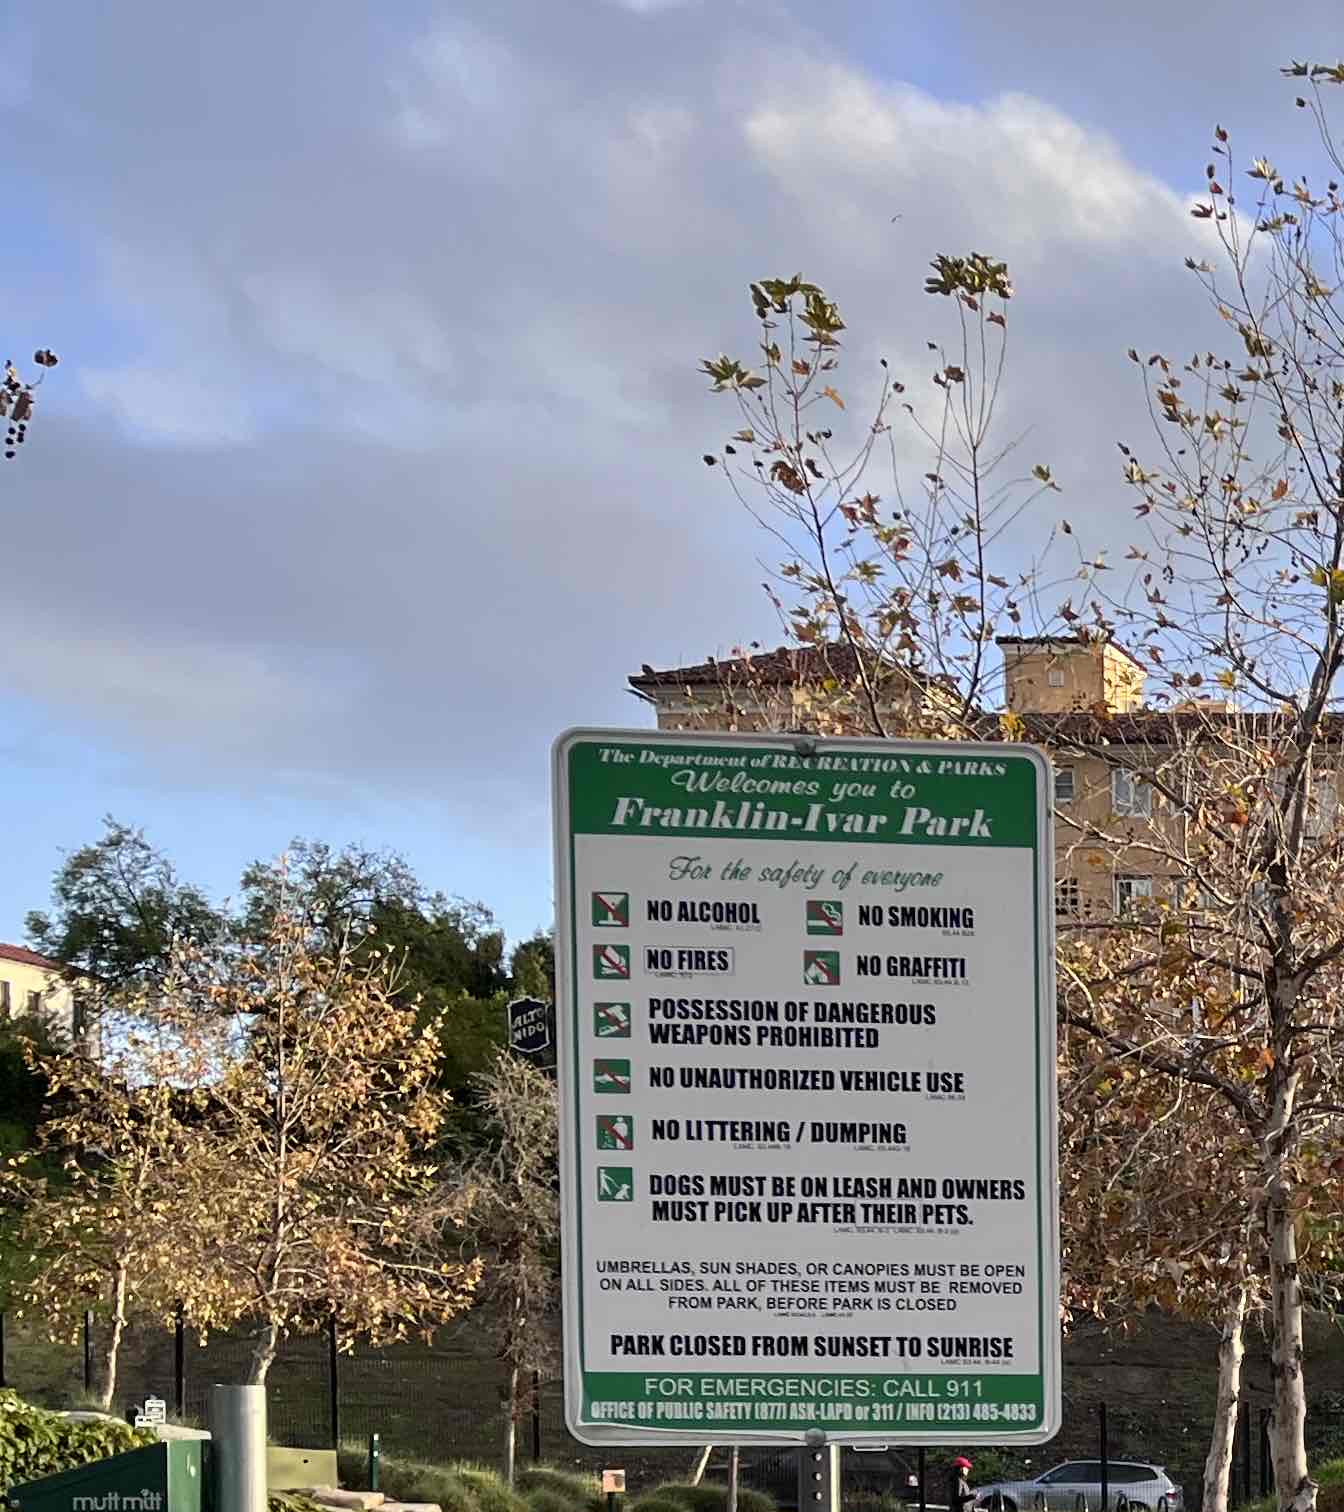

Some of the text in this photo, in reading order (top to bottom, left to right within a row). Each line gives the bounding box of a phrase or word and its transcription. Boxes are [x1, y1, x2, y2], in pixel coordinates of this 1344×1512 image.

[600, 749, 1007, 776] The Department of RECREATION & PARKS
[671, 769, 916, 801] Welcomes you to
[609, 797, 993, 838] Franklin-Ivar Park
[669, 856, 944, 892] For the safety of everyone
[647, 900, 760, 925] NO ALCOHOL
[859, 905, 974, 931] NO SMOKING
[647, 949, 729, 973] NO FIRES
[857, 955, 967, 980] NO GRAFFITI
[649, 998, 936, 1027] POSSESSION OF DANGEROUS
[513, 1022, 545, 1043] NIDO
[649, 1024, 878, 1048] WEAPONS PROHIBITED
[650, 1067, 965, 1095] NO UNAUTHORIZED VEHICLE USE
[653, 1120, 906, 1146] NO LITTERING / DUMPING
[650, 1175, 1025, 1200] DOGS MUST BE ON LEASH AND OWNERS
[653, 1201, 973, 1226] MUST PICK UP AFTER THEIR PETS.
[597, 1261, 1024, 1277] UMBRELLAS, SUN SHADES, OR CANOPIES MUST BE OPEN
[600, 1278, 1022, 1294] ON ALL SIDES. ALL OF THESE ITEMS MUST BE REMOVED
[669, 1297, 956, 1310] FROM PARK, BEFORE PARK IS CLOSED
[611, 1335, 1013, 1360] PARK CLOSED FROM SUNSET TO SUNRISE
[646, 1379, 983, 1397] FOR EMERGENCIES: CALL 911
[591, 1401, 634, 1419] OFFICE
[637, 1401, 653, 1419] OF
[655, 1402, 703, 1420] PUBLIC
[706, 1402, 752, 1420] SAFETY
[789, 1403, 852, 1420] ASK-LAPD
[855, 1405, 869, 1420] or
[872, 1403, 893, 1420] 311
[895, 1403, 903, 1420] /
[906, 1403, 934, 1420] INFO
[937, 1403, 970, 1420] (213)
